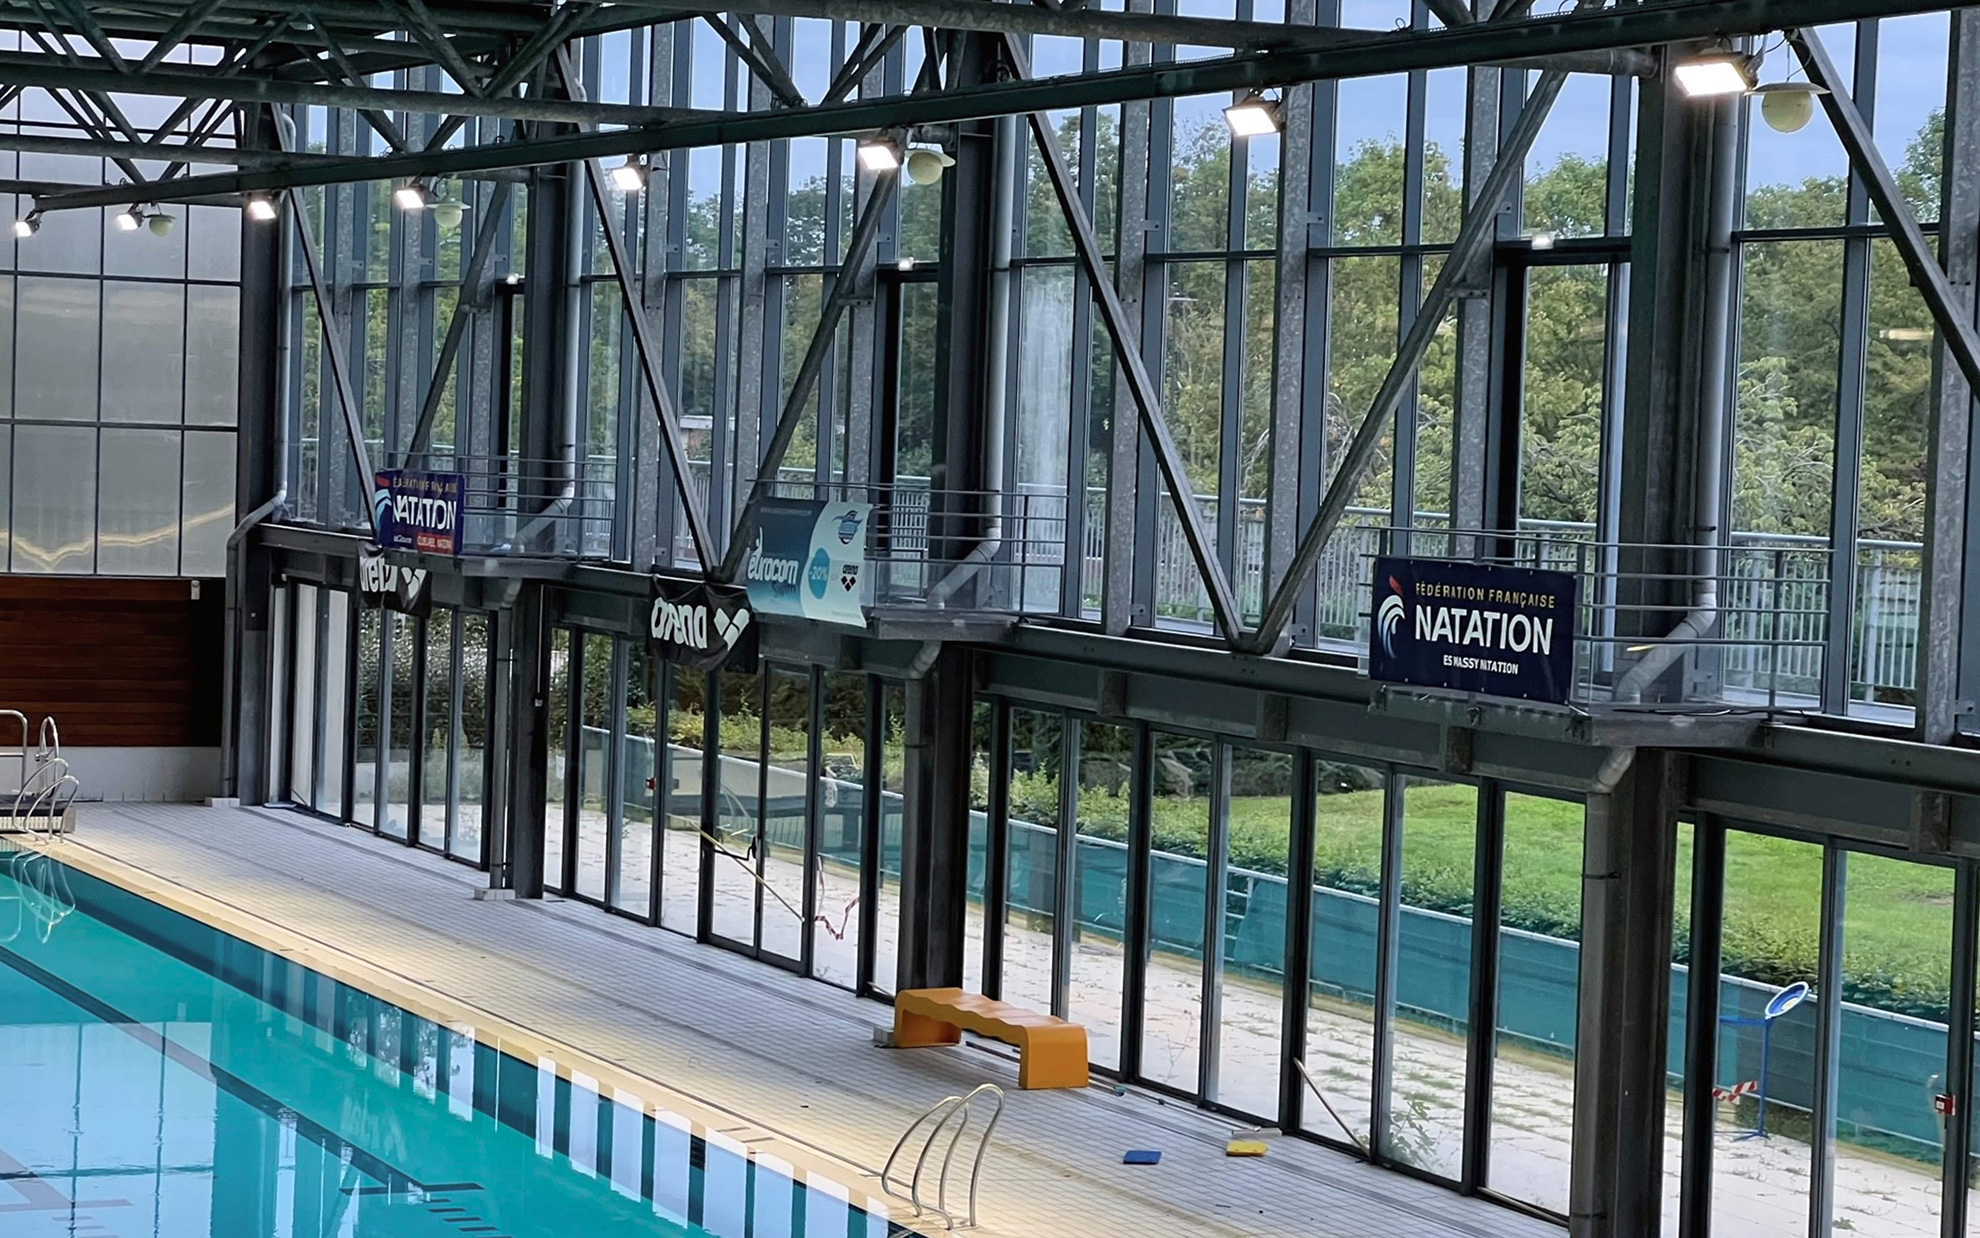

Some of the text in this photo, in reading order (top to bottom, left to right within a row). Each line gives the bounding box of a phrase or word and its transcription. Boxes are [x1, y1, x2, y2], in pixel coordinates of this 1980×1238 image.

[393, 495, 457, 530] NATATION
[1416, 581, 1555, 608] FÉDÉRATION FRANÇAISE
[651, 597, 707, 649] arena
[1415, 605, 1553, 655] NATATION
[1443, 655, 1453, 666] ES
